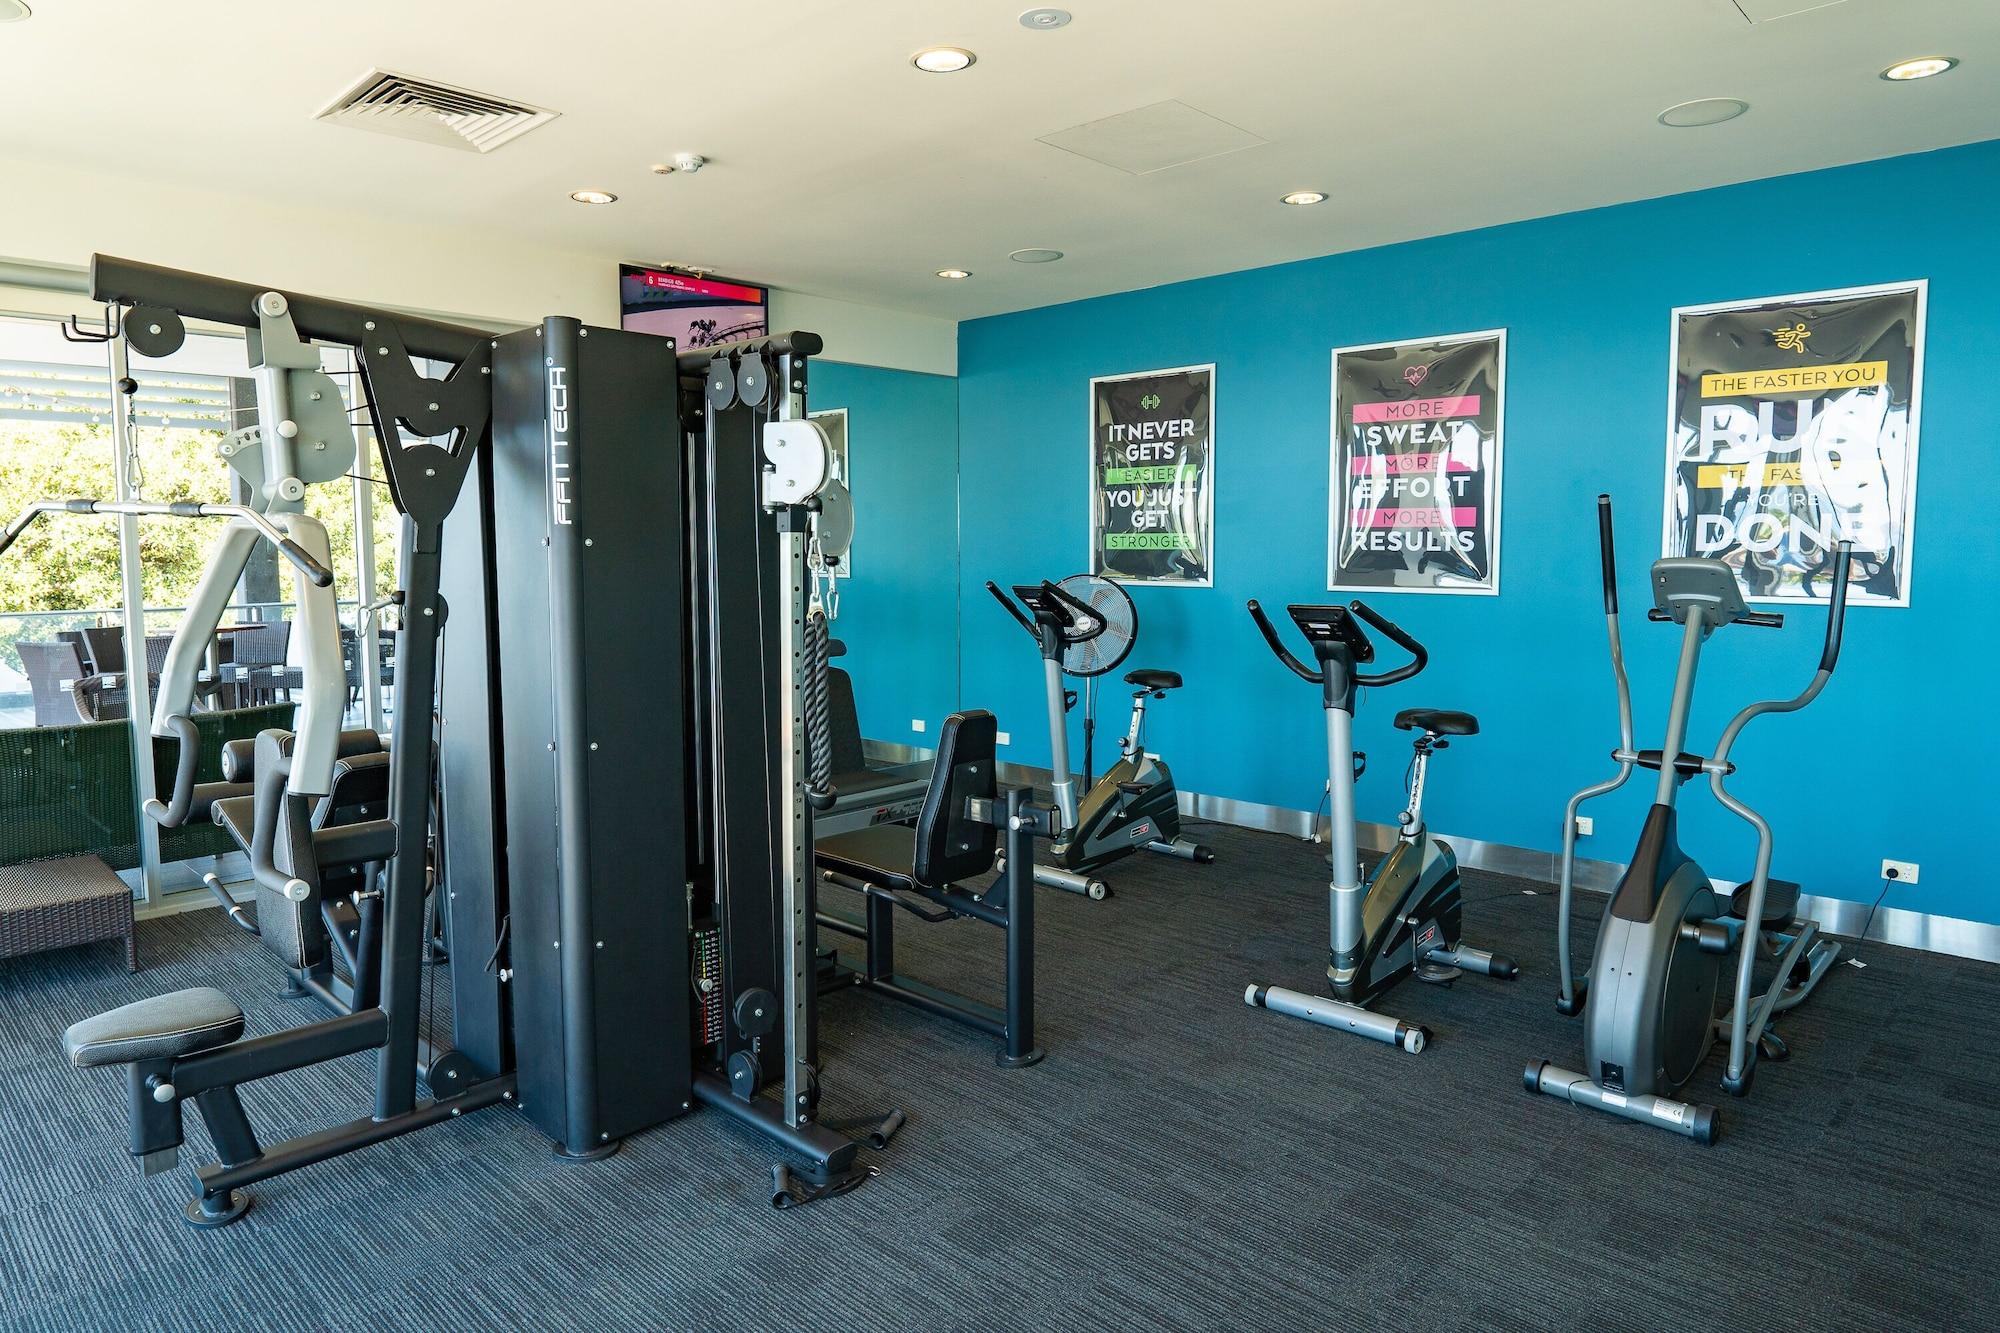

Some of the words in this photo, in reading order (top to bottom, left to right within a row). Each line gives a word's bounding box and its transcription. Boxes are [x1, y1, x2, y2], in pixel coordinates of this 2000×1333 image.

[1711, 377, 1748, 392] THE
[1753, 371, 1828, 389] FASTER
[1834, 366, 1877, 384] YOU
[1386, 401, 1444, 418] MORE
[1108, 424, 1126, 443] IT
[1128, 418, 1195, 441] NEVER
[1366, 421, 1464, 447] SWEAT
[1125, 441, 1175, 462] GETS
[1124, 467, 1177, 482] EASIER
[1106, 490, 1145, 508] YOU
[1149, 487, 1198, 507] JUST
[1131, 510, 1169, 529] GET
[1383, 510, 1441, 525] MORE
[1111, 535, 1191, 548] STRONGER
[1352, 530, 1475, 552] RESULTS
